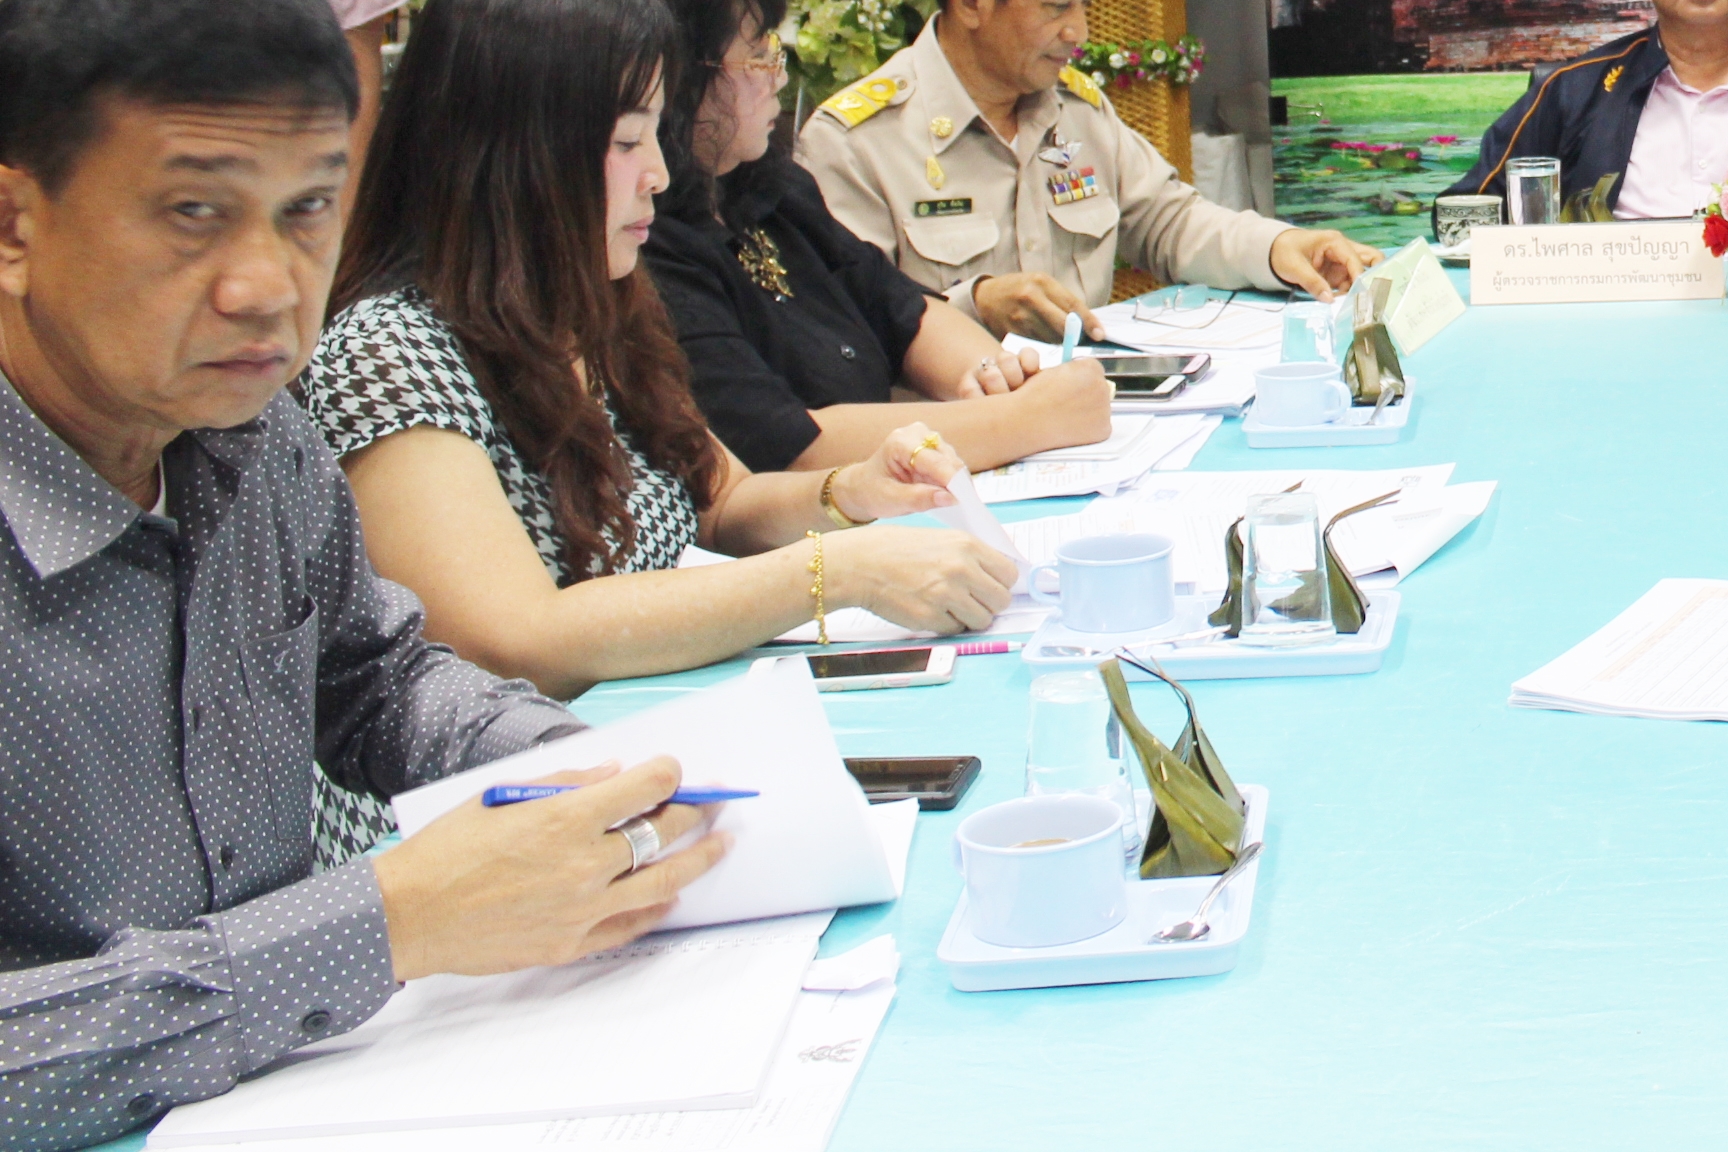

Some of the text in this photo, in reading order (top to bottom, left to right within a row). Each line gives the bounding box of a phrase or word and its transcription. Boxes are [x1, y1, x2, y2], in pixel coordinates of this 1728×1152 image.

[1503, 235, 1691, 262] ดร.ไพศาล สุขปัญญา
